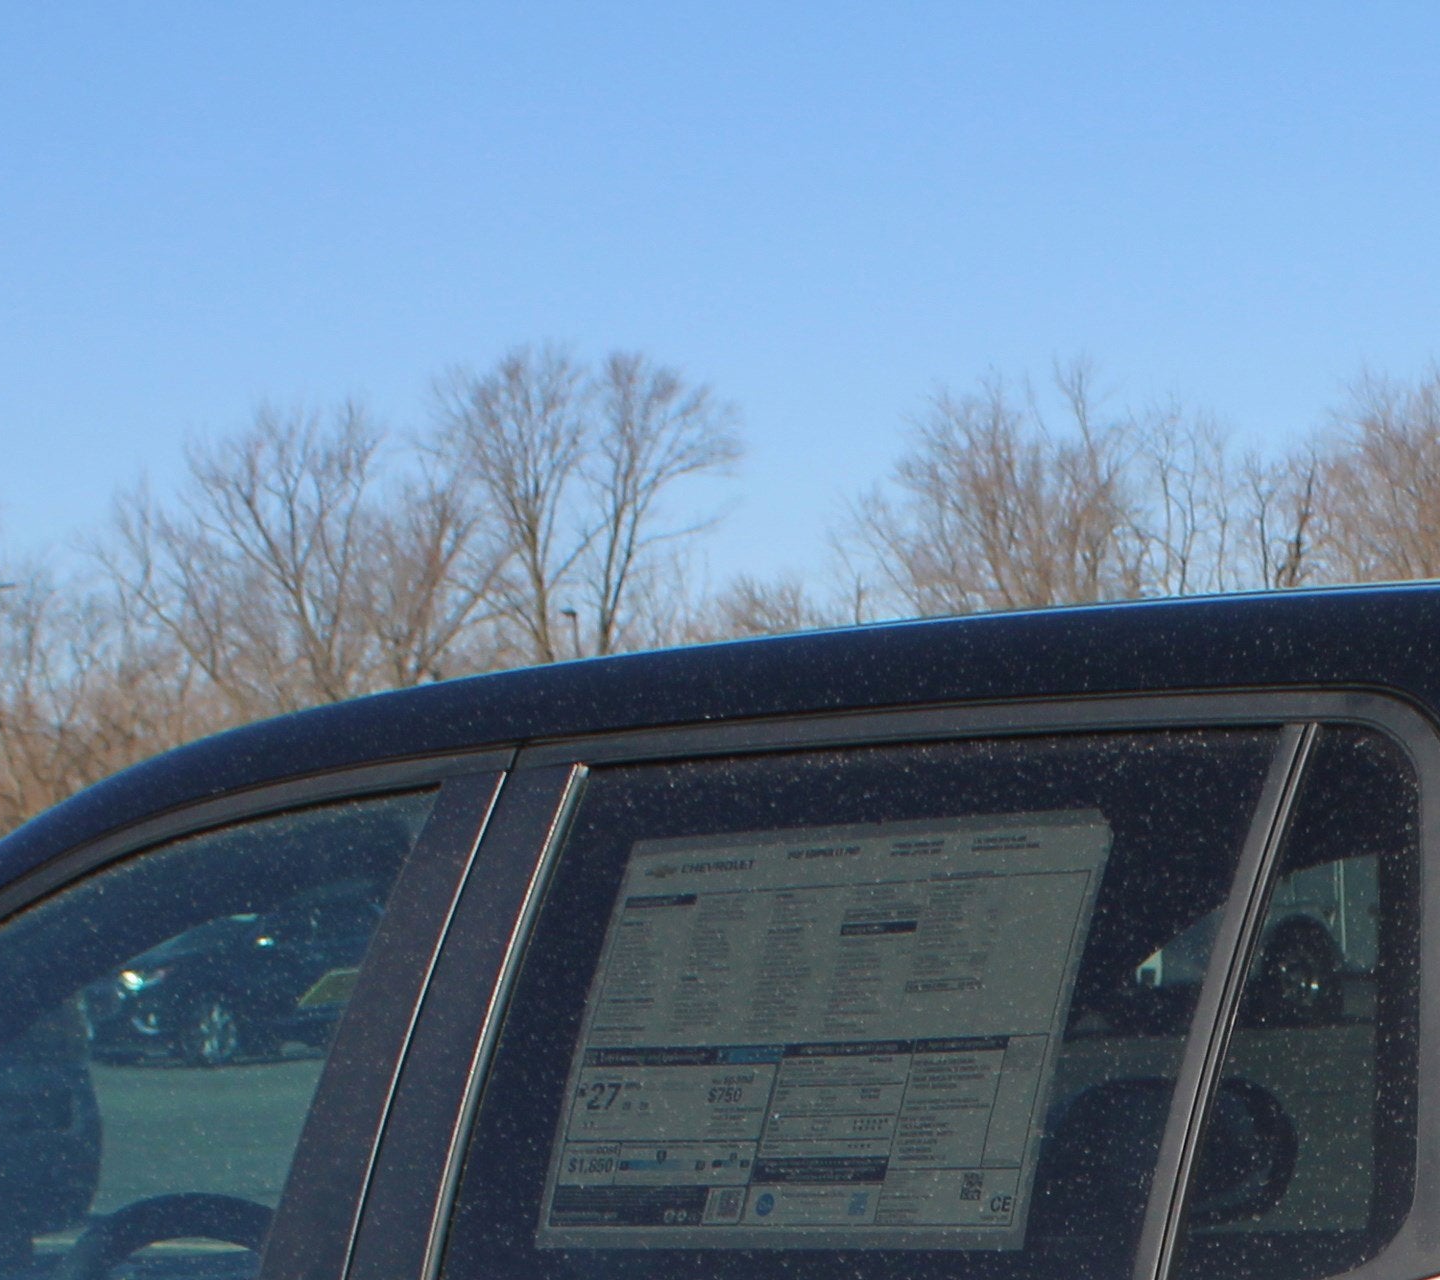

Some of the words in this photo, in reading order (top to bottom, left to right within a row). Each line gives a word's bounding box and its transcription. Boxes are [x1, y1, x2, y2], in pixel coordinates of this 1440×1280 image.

[681, 859, 754, 873] CHEVROLET
[587, 1082, 622, 1110] 27
[990, 1196, 1012, 1212] CE
